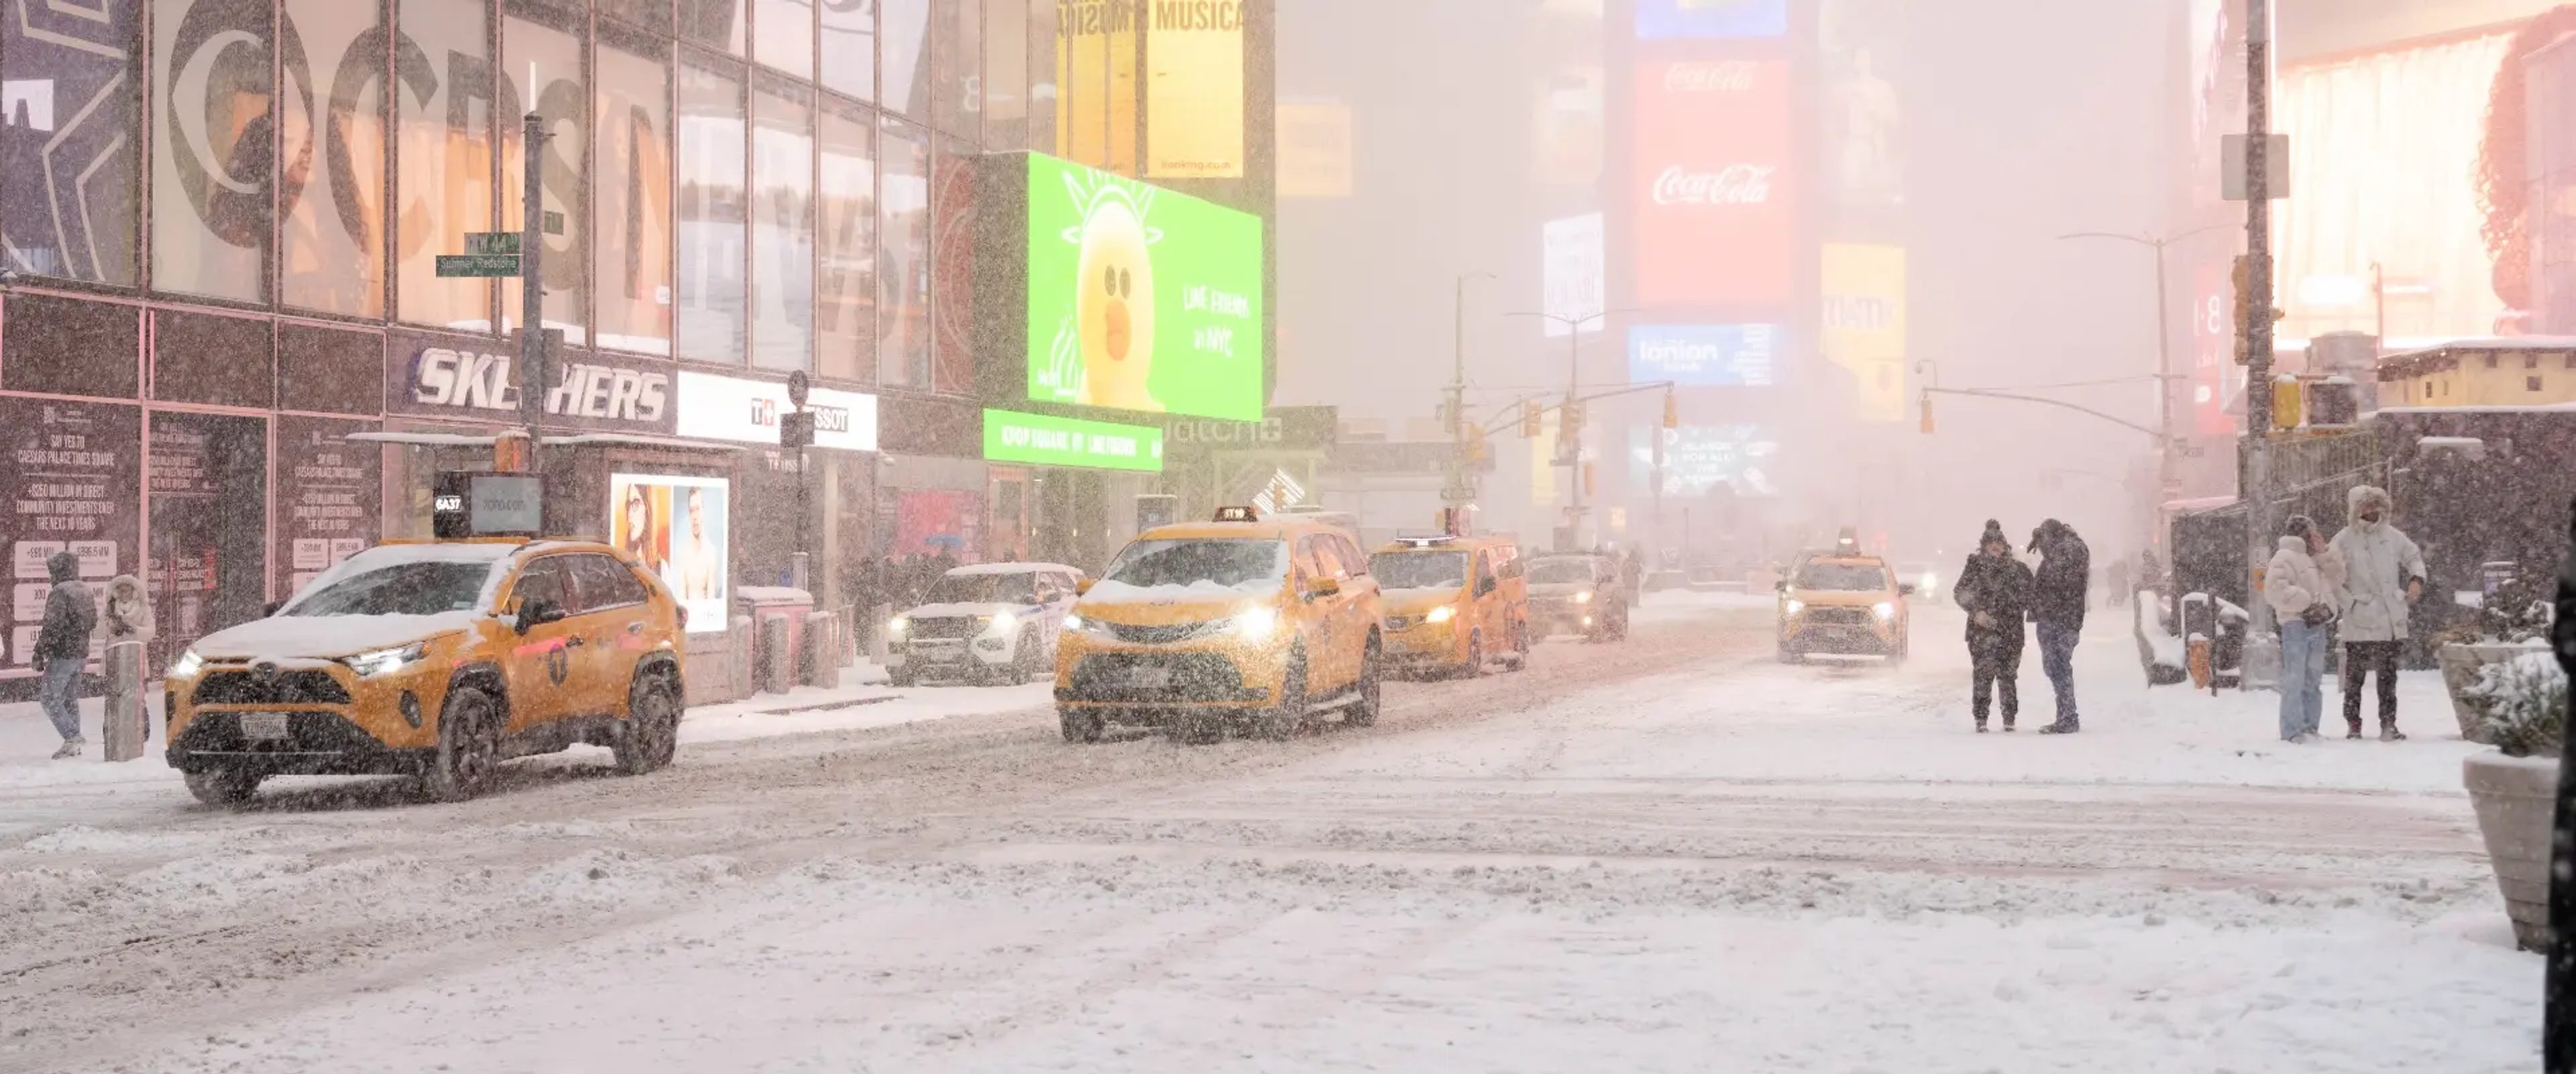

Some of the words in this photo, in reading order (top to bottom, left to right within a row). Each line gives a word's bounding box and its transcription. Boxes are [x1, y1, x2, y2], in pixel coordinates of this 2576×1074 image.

[1654, 166, 1775, 203] Coca-Cola
[1183, 284, 1207, 311] LINE
[51, 435, 62, 447] SAY
[18, 450, 47, 464] CAESARS
[17, 500, 54, 513] COMMUNITY
[56, 500, 97, 514] INVESTMENTS
[37, 517, 49, 529] THE
[50, 517, 66, 530] NEXT
